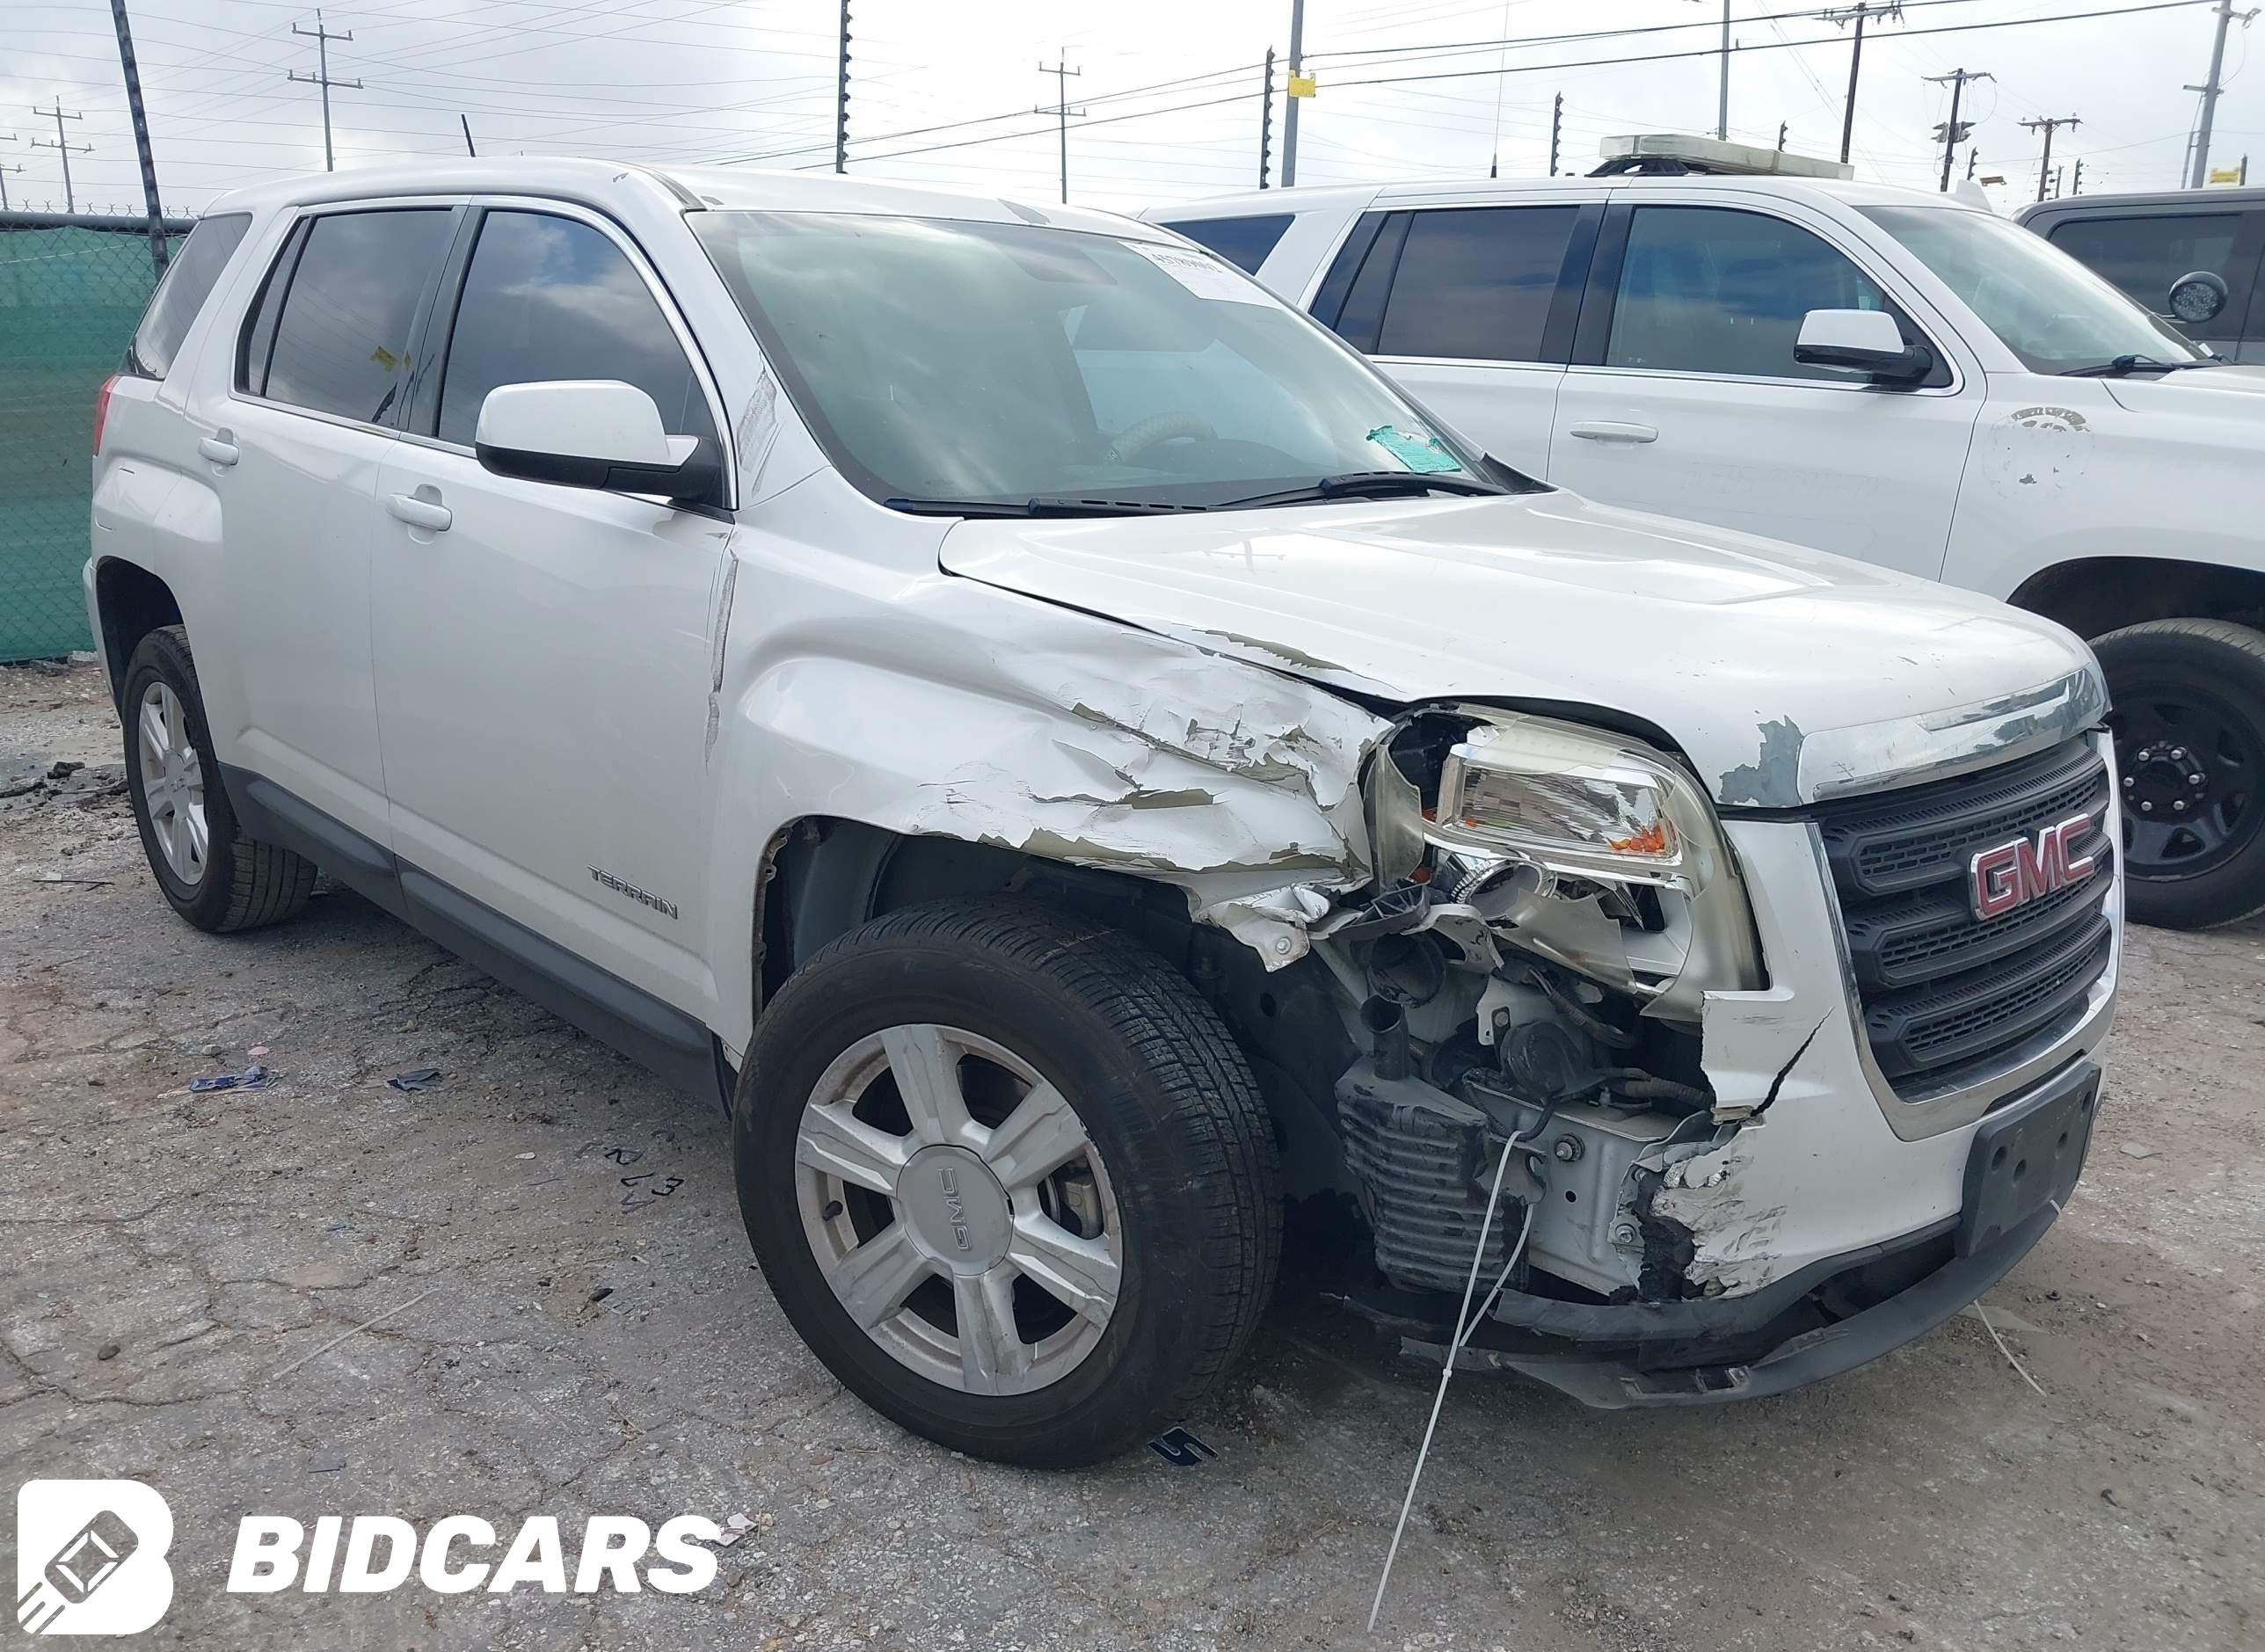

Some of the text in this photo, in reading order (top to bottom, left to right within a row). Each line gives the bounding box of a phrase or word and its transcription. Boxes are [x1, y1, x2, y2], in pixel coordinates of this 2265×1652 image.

[586, 863, 678, 920] TERRAIN
[1970, 812, 2094, 921] GMC
[936, 1168, 972, 1251] GMC
